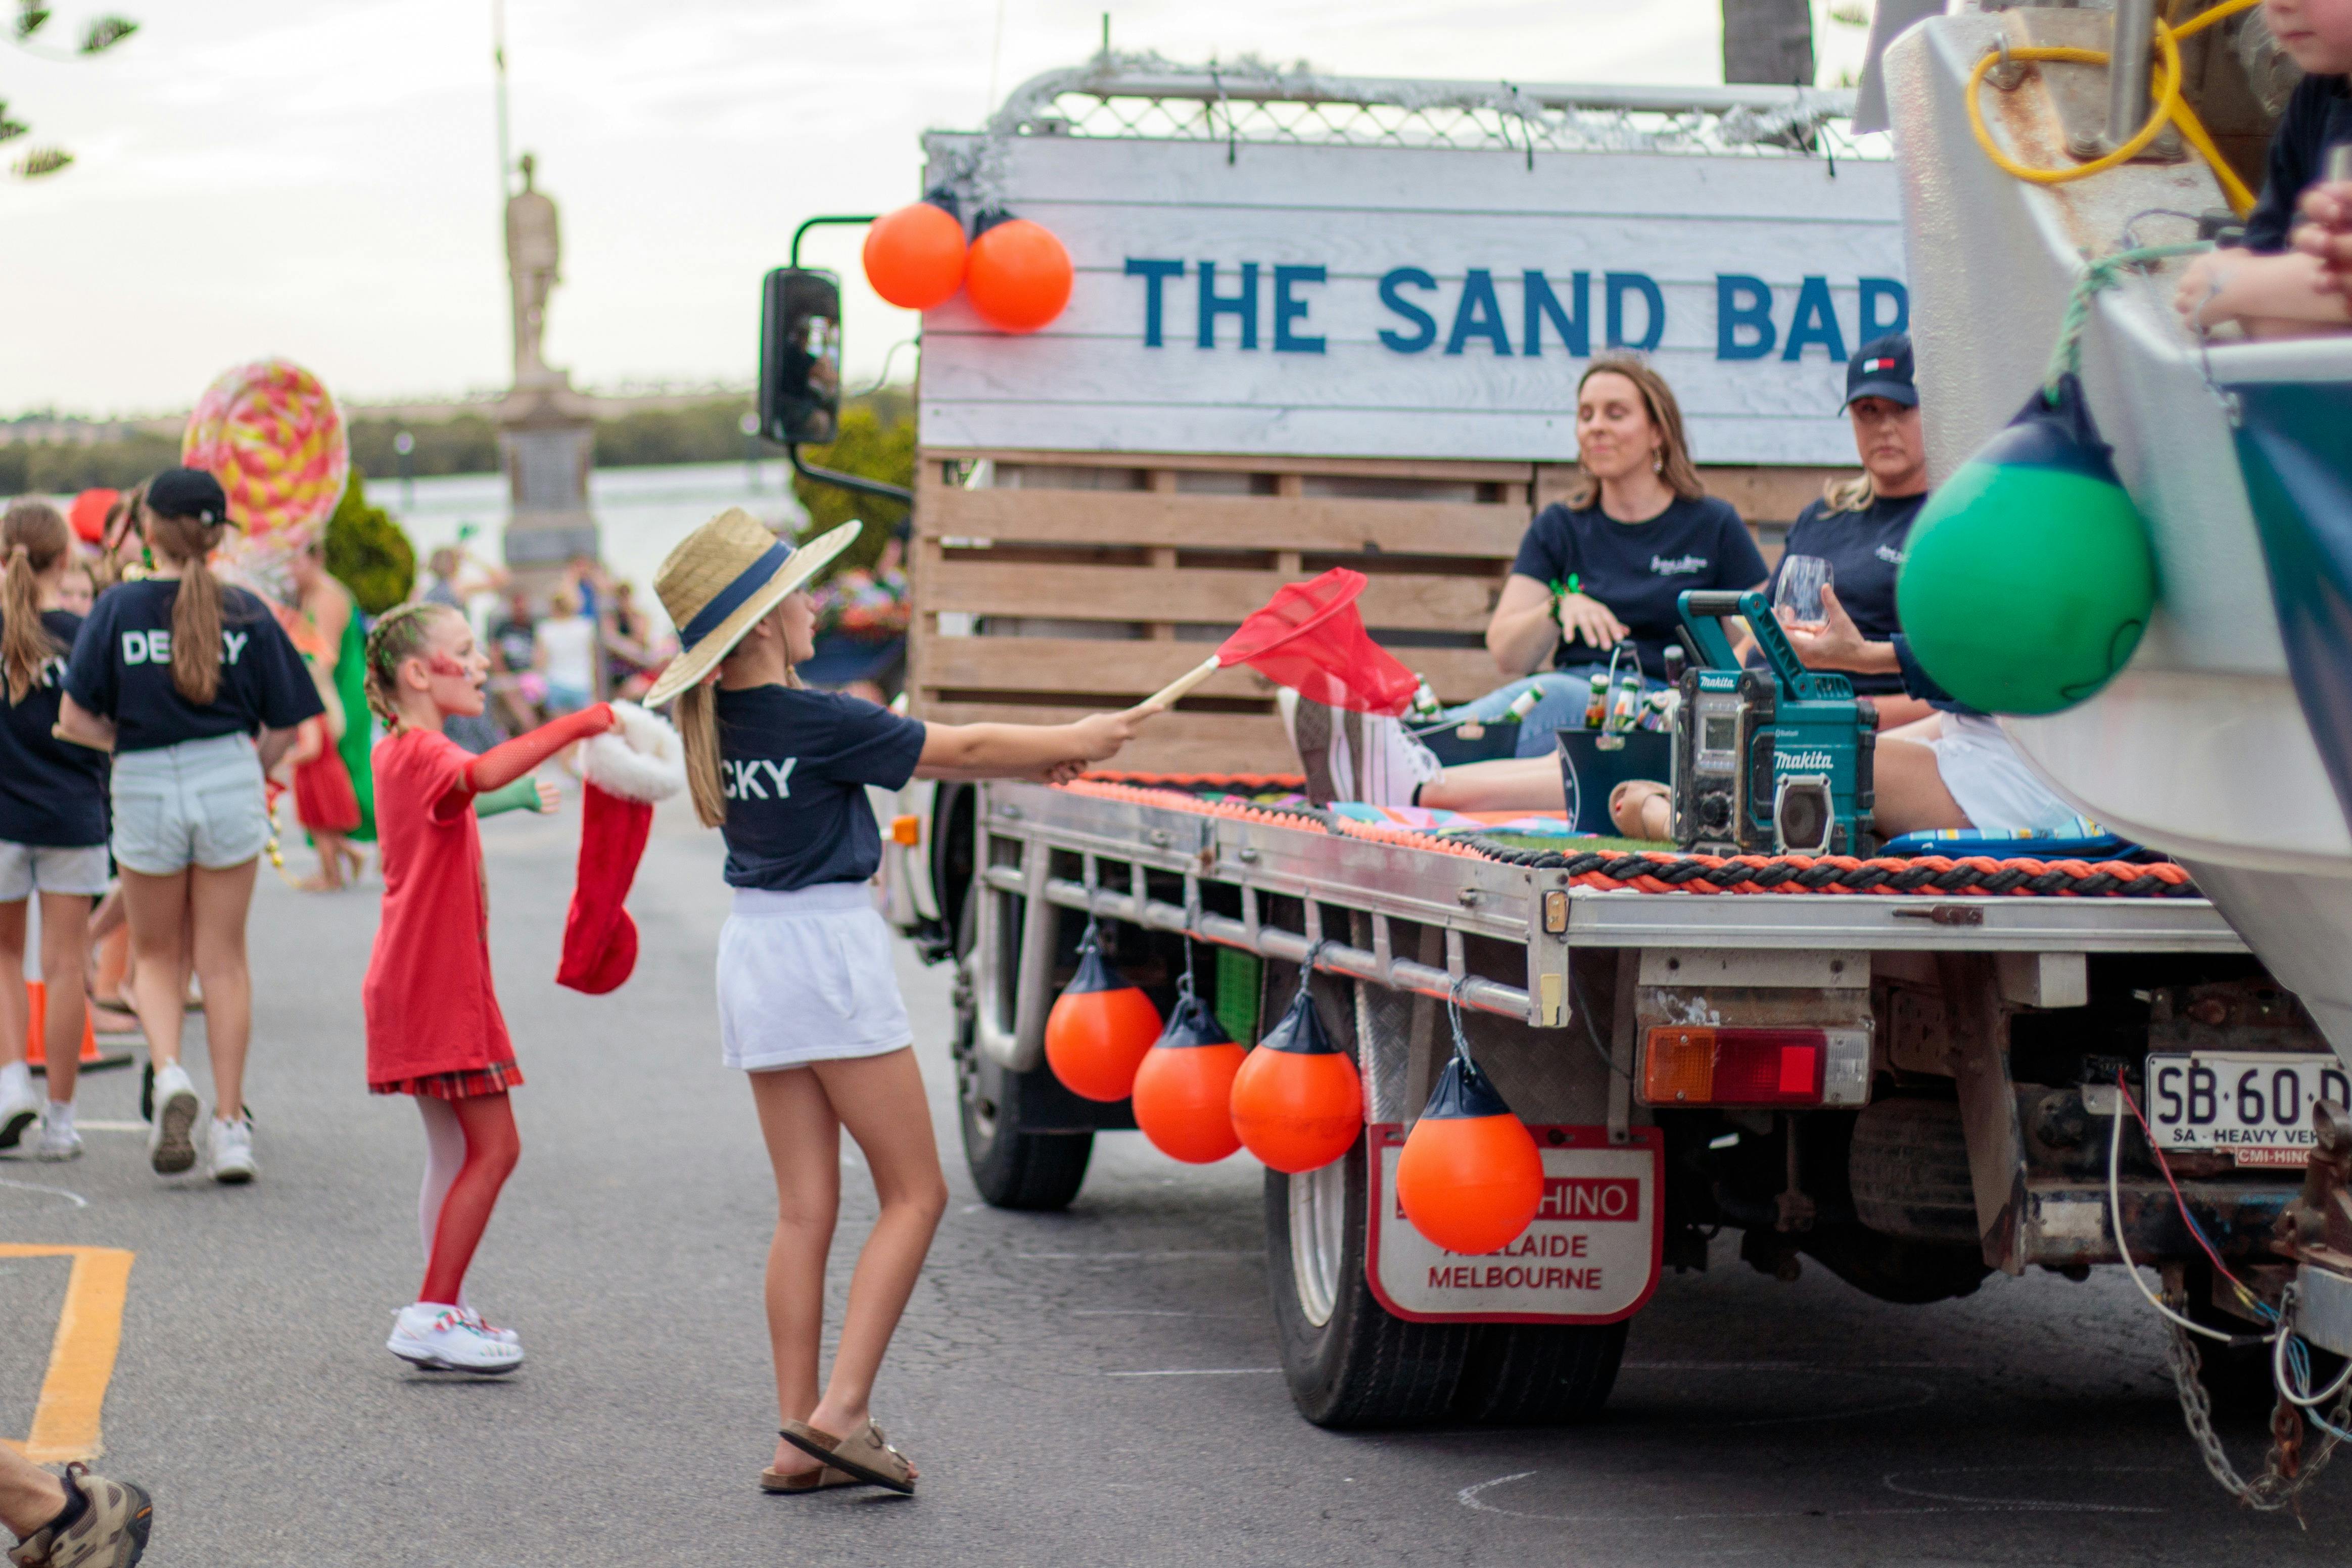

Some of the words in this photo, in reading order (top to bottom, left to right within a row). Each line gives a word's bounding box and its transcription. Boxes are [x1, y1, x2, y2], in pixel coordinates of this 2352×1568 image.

[1124, 257, 1327, 354] THE
[1378, 266, 1666, 358] SAND
[121, 629, 249, 666] DEY
[720, 757, 797, 801] CKY
[2174, 1128, 2196, 1142] SA
[2214, 1128, 2277, 1144] HEAVY
[1538, 1184, 1628, 1216] HINO
[1427, 1265, 1602, 1291] MELBOURNE
